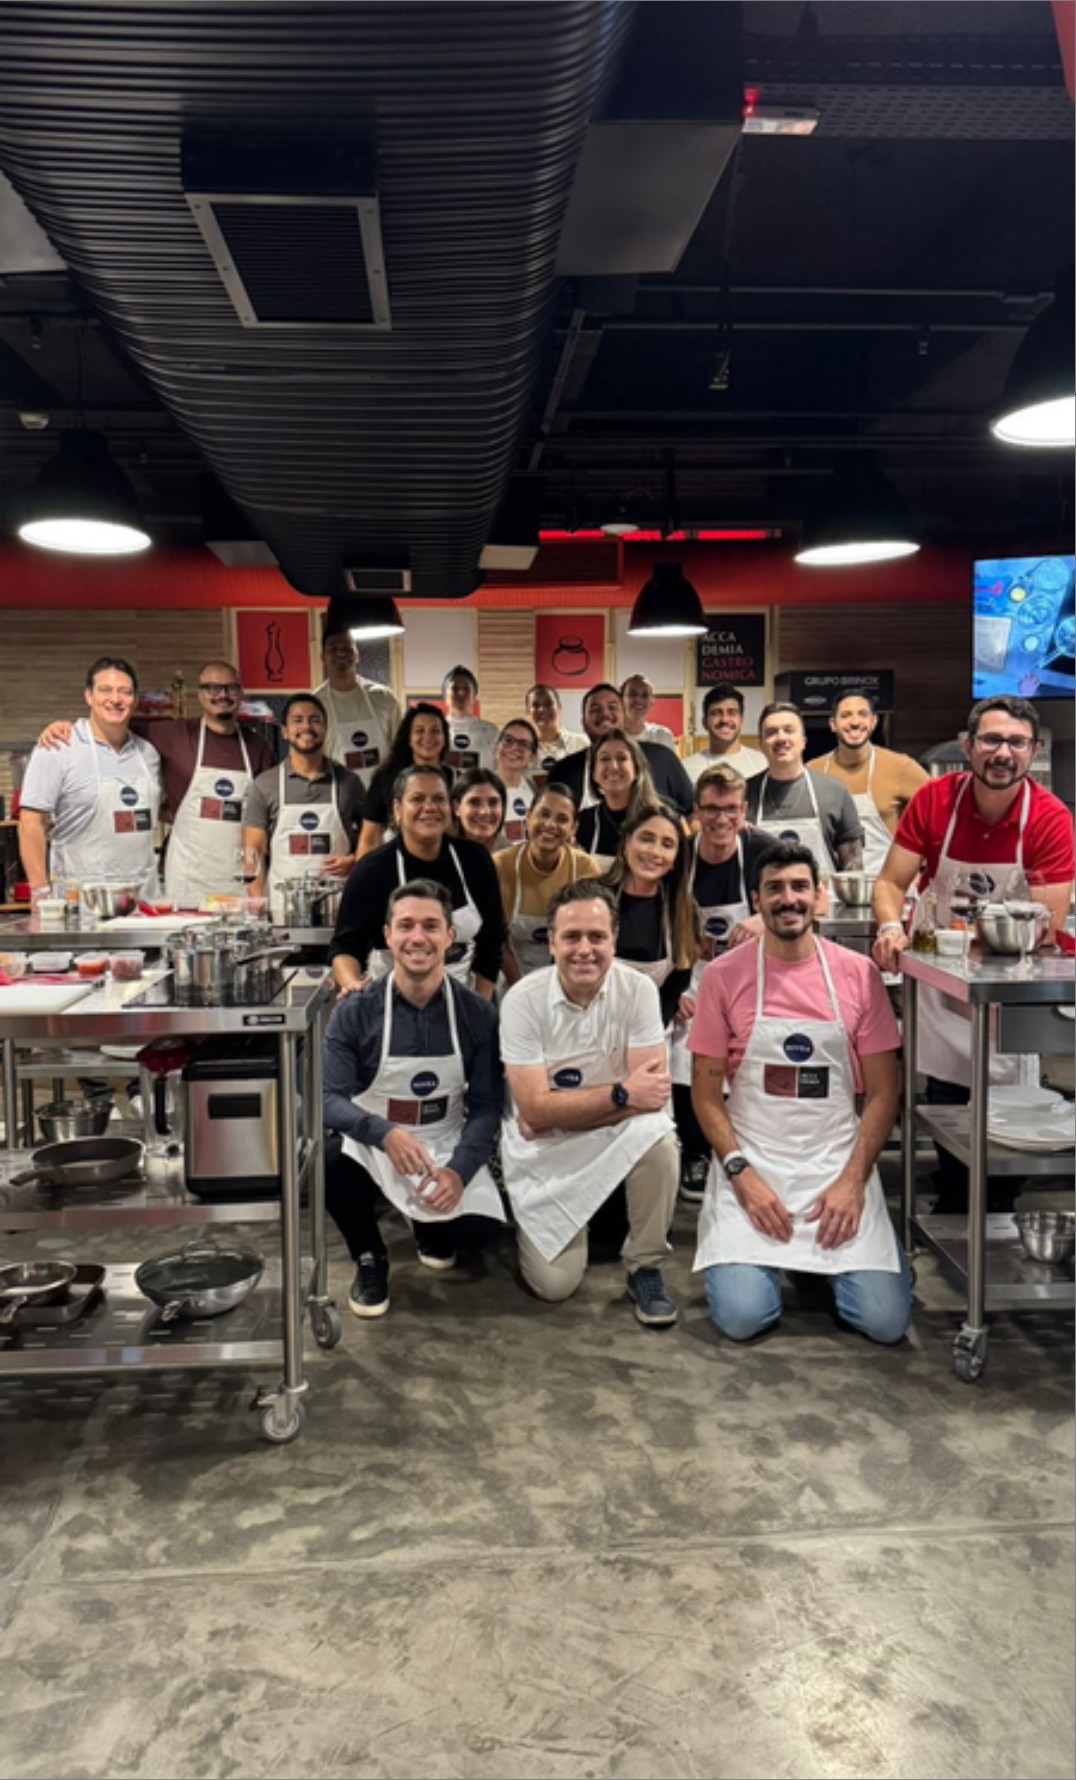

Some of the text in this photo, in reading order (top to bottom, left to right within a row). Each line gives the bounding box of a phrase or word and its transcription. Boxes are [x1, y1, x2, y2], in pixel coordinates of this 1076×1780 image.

[703, 631, 736, 642] ACCA
[702, 644, 744, 656] DEMIA
[702, 656, 753, 668] GASTRO
[702, 669, 756, 681] NOMICA
[804, 676, 879, 686] GRUPO BRINOX
